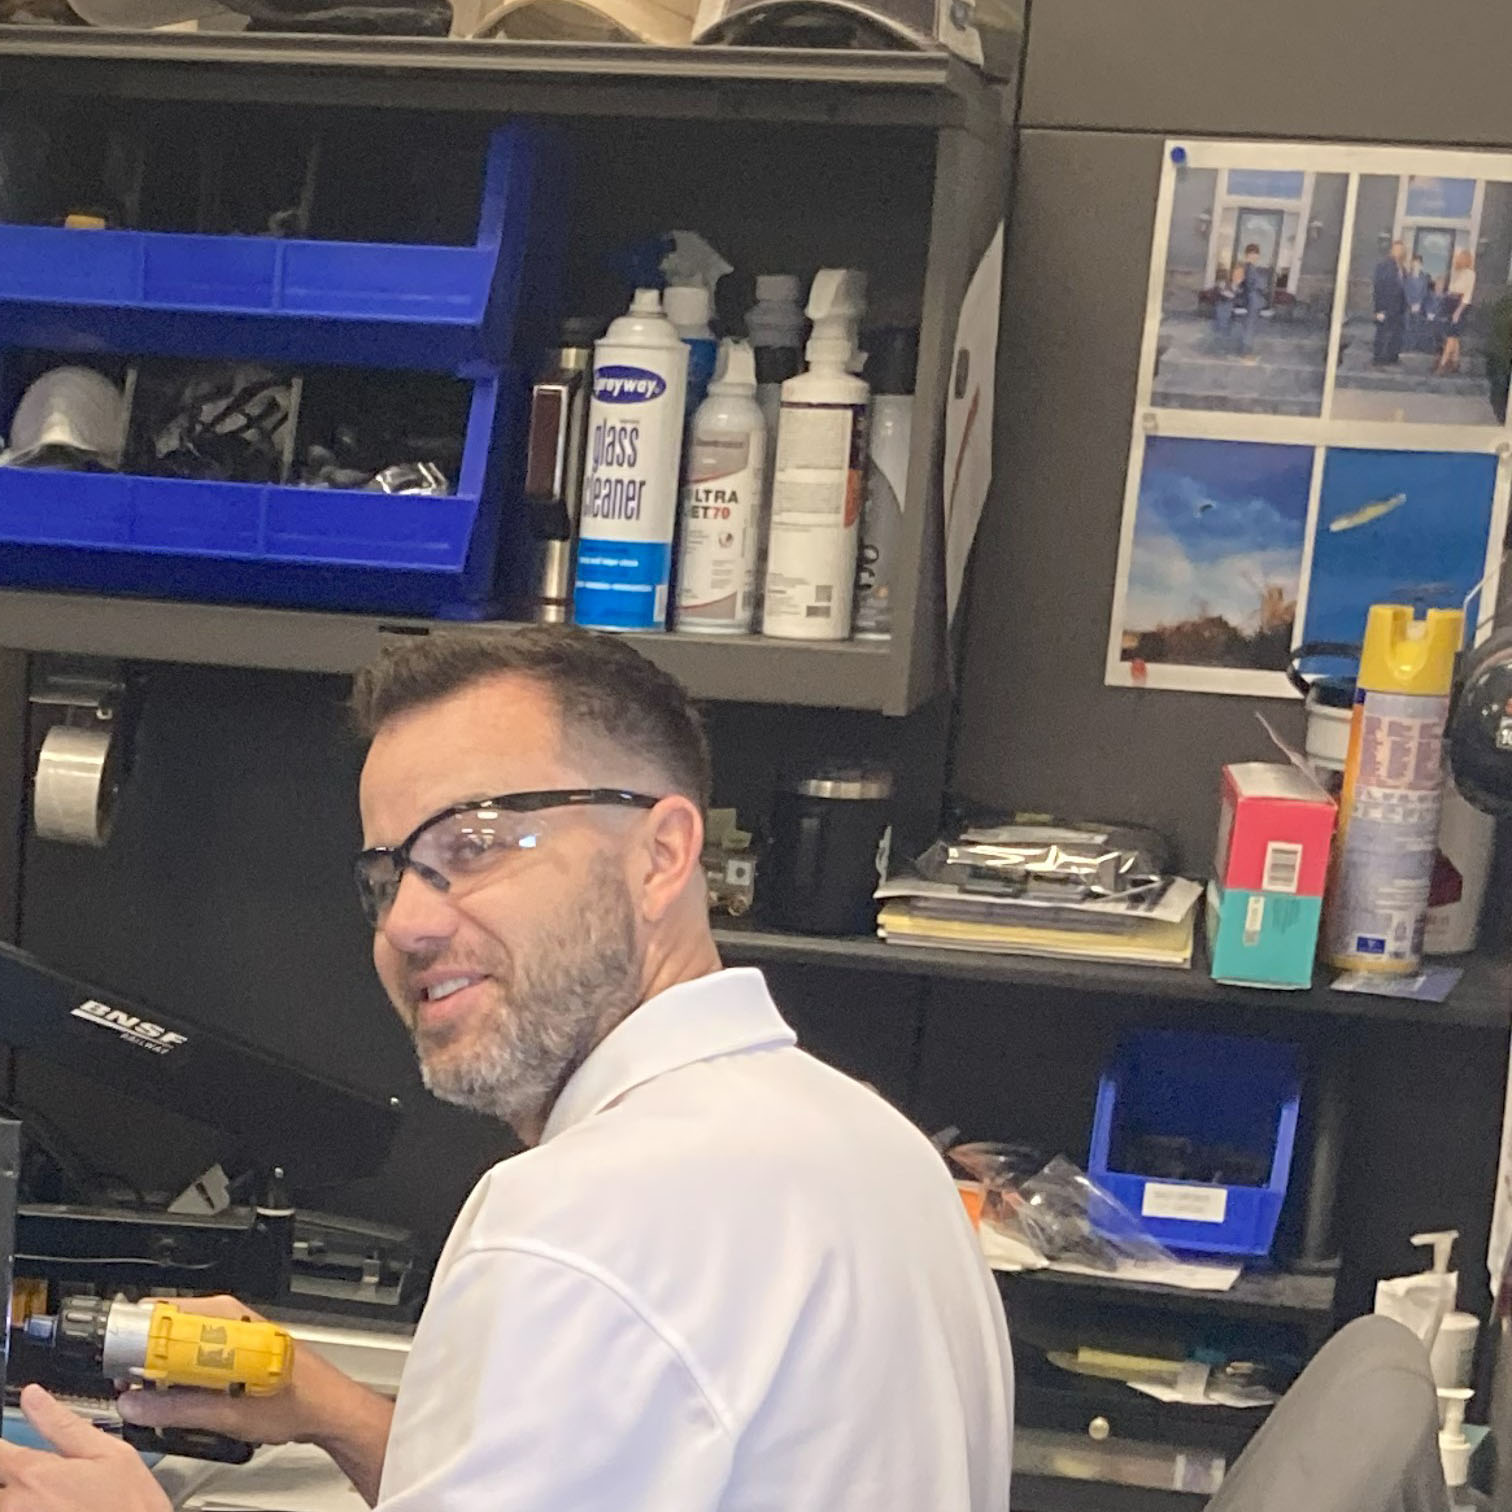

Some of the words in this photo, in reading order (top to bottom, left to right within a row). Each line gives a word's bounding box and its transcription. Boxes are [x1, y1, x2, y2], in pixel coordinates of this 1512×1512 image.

[591, 417, 639, 474] glass
[685, 488, 739, 504] LTRA
[79, 999, 189, 1045] BNSF
